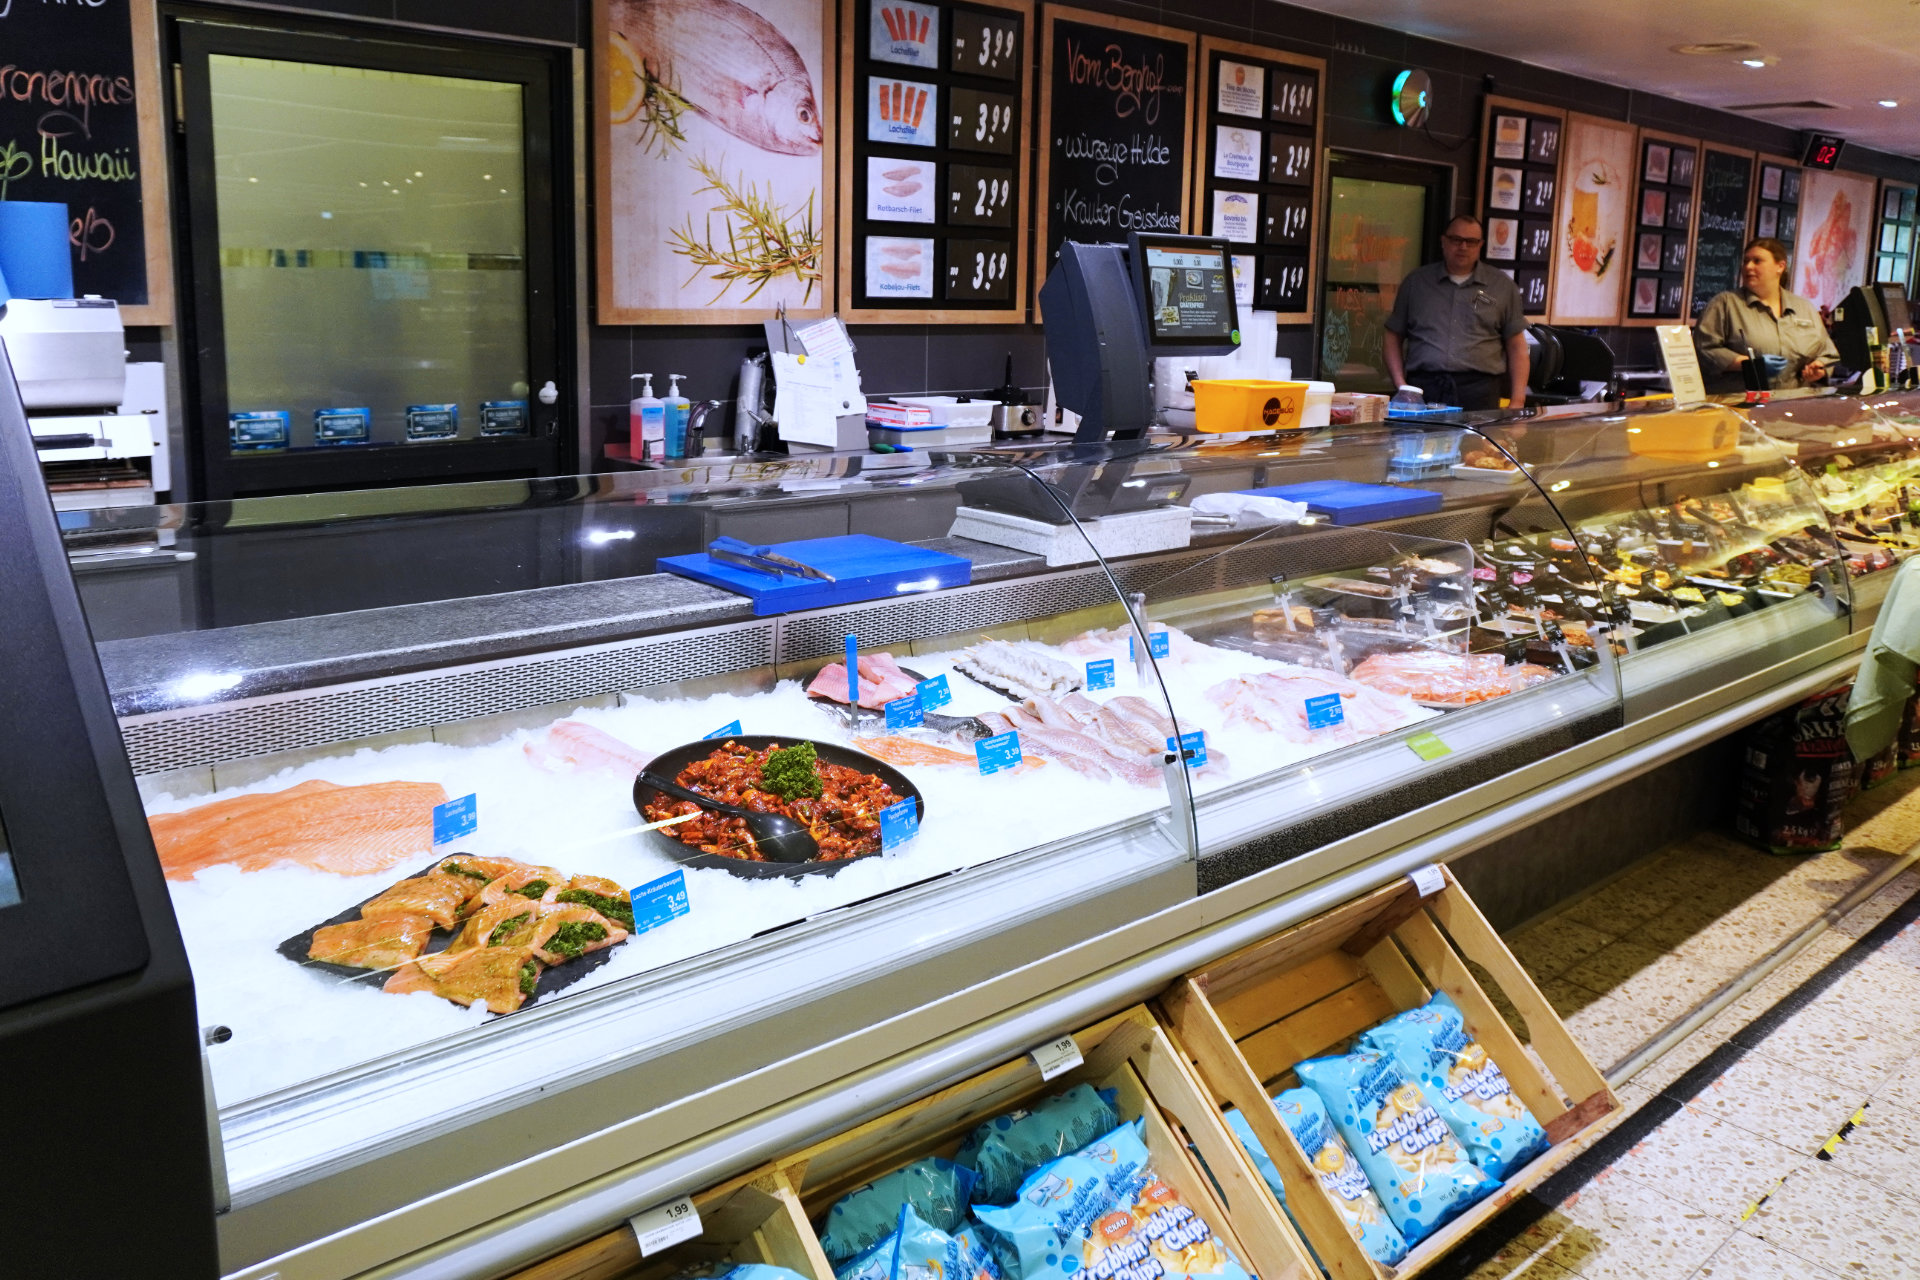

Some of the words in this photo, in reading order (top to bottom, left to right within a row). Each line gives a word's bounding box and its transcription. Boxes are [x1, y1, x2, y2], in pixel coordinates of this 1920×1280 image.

[1067, 37, 1103, 87] Vom
[41, 133, 137, 181] Hawaii
[1131, 133, 1170, 165] Hilde
[1817, 145, 1836, 164] 02
[974, 178, 1010, 217] 2.99
[667, 890, 686, 909] 3.49
[1366, 1105, 1440, 1156] Krabben
[665, 1203, 689, 1218] 1.99
[1131, 1204, 1196, 1249] rabben
[1163, 1217, 1211, 1252] Chips
